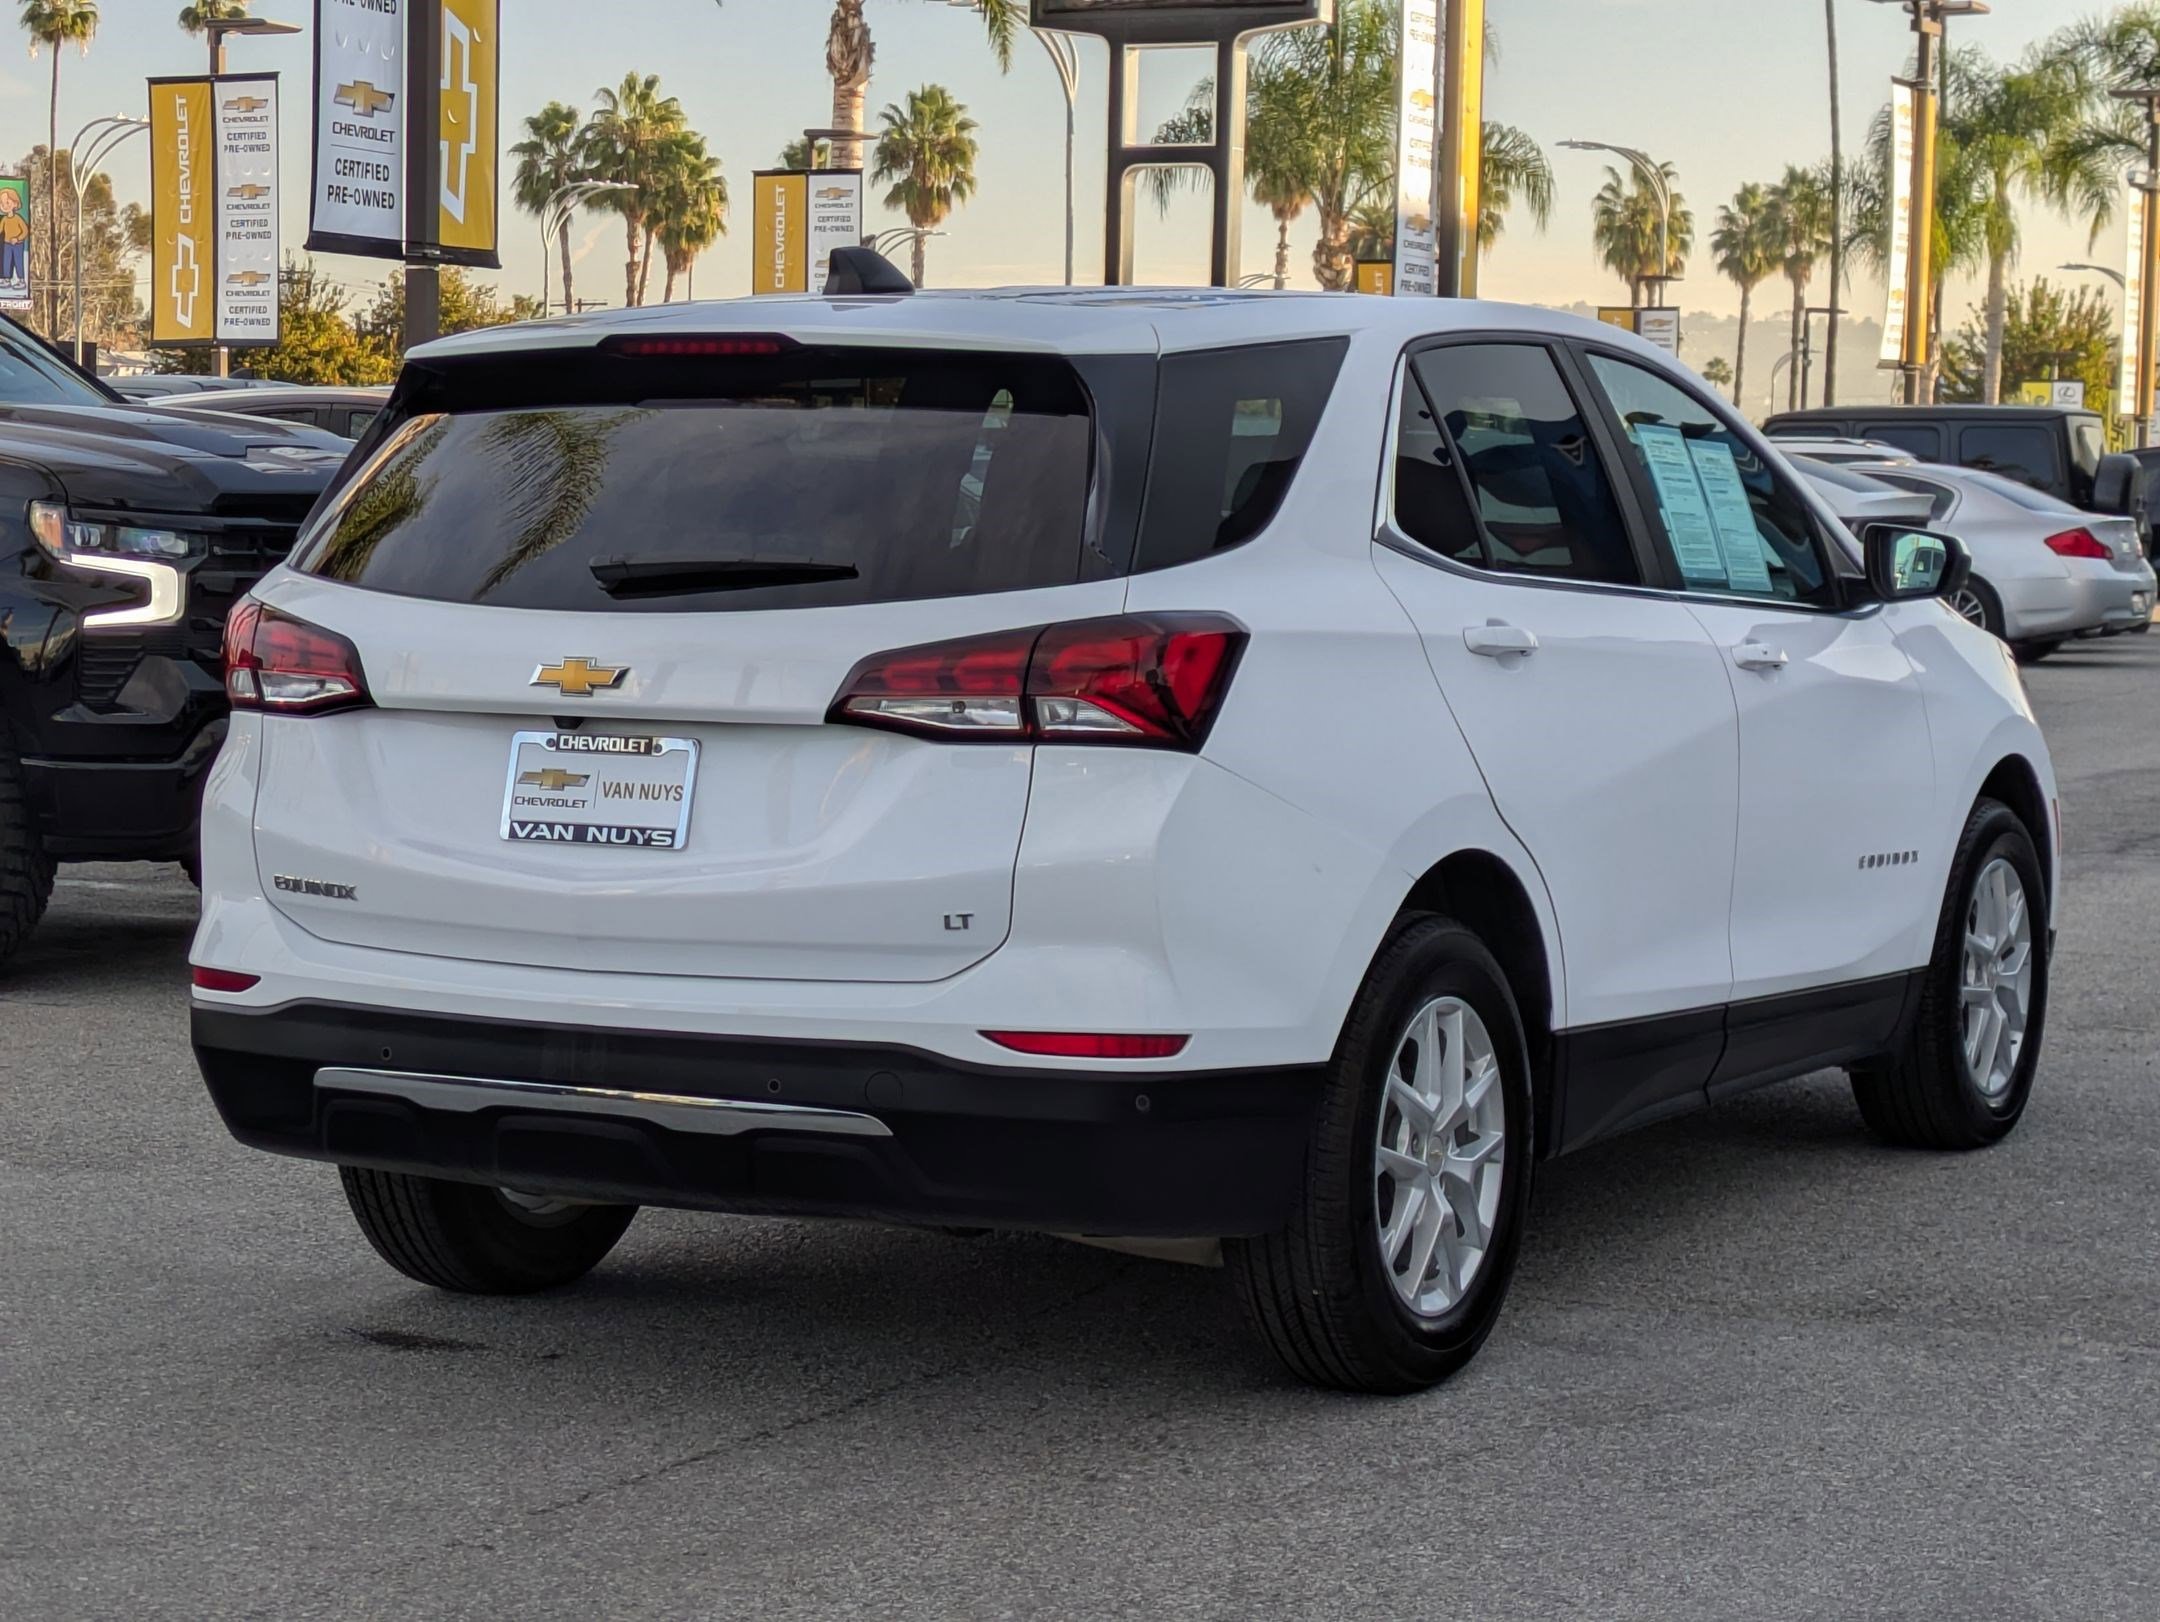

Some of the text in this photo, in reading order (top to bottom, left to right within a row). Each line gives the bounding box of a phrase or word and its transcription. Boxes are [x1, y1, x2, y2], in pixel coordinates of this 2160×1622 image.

[223, 115, 269, 123] CHEVROLET
[227, 131, 267, 141] CERTIFIED
[332, 121, 396, 143] CHEVROLET
[224, 143, 271, 153] PRE-OWNED
[175, 93, 192, 223] CHEVROLET
[335, 158, 390, 182] CERTIFIED
[327, 184, 396, 210] PRE-OWNED
[231, 219, 268, 228] CERTIFIED
[817, 215, 852, 223] CERTIFIED
[226, 231, 272, 240] PRE-OWNED
[775, 184, 786, 289] CHEVROLET
[229, 306, 268, 315] CERTIFIED
[224, 318, 271, 327] PRE-OWNED
[559, 735, 649, 753] CHEVROLET
[602, 781, 684, 802] VAN NUYS
[514, 796, 588, 809] CHEVROLET
[512, 822, 673, 846] VAN NUYS
[943, 913, 975, 930] LT
